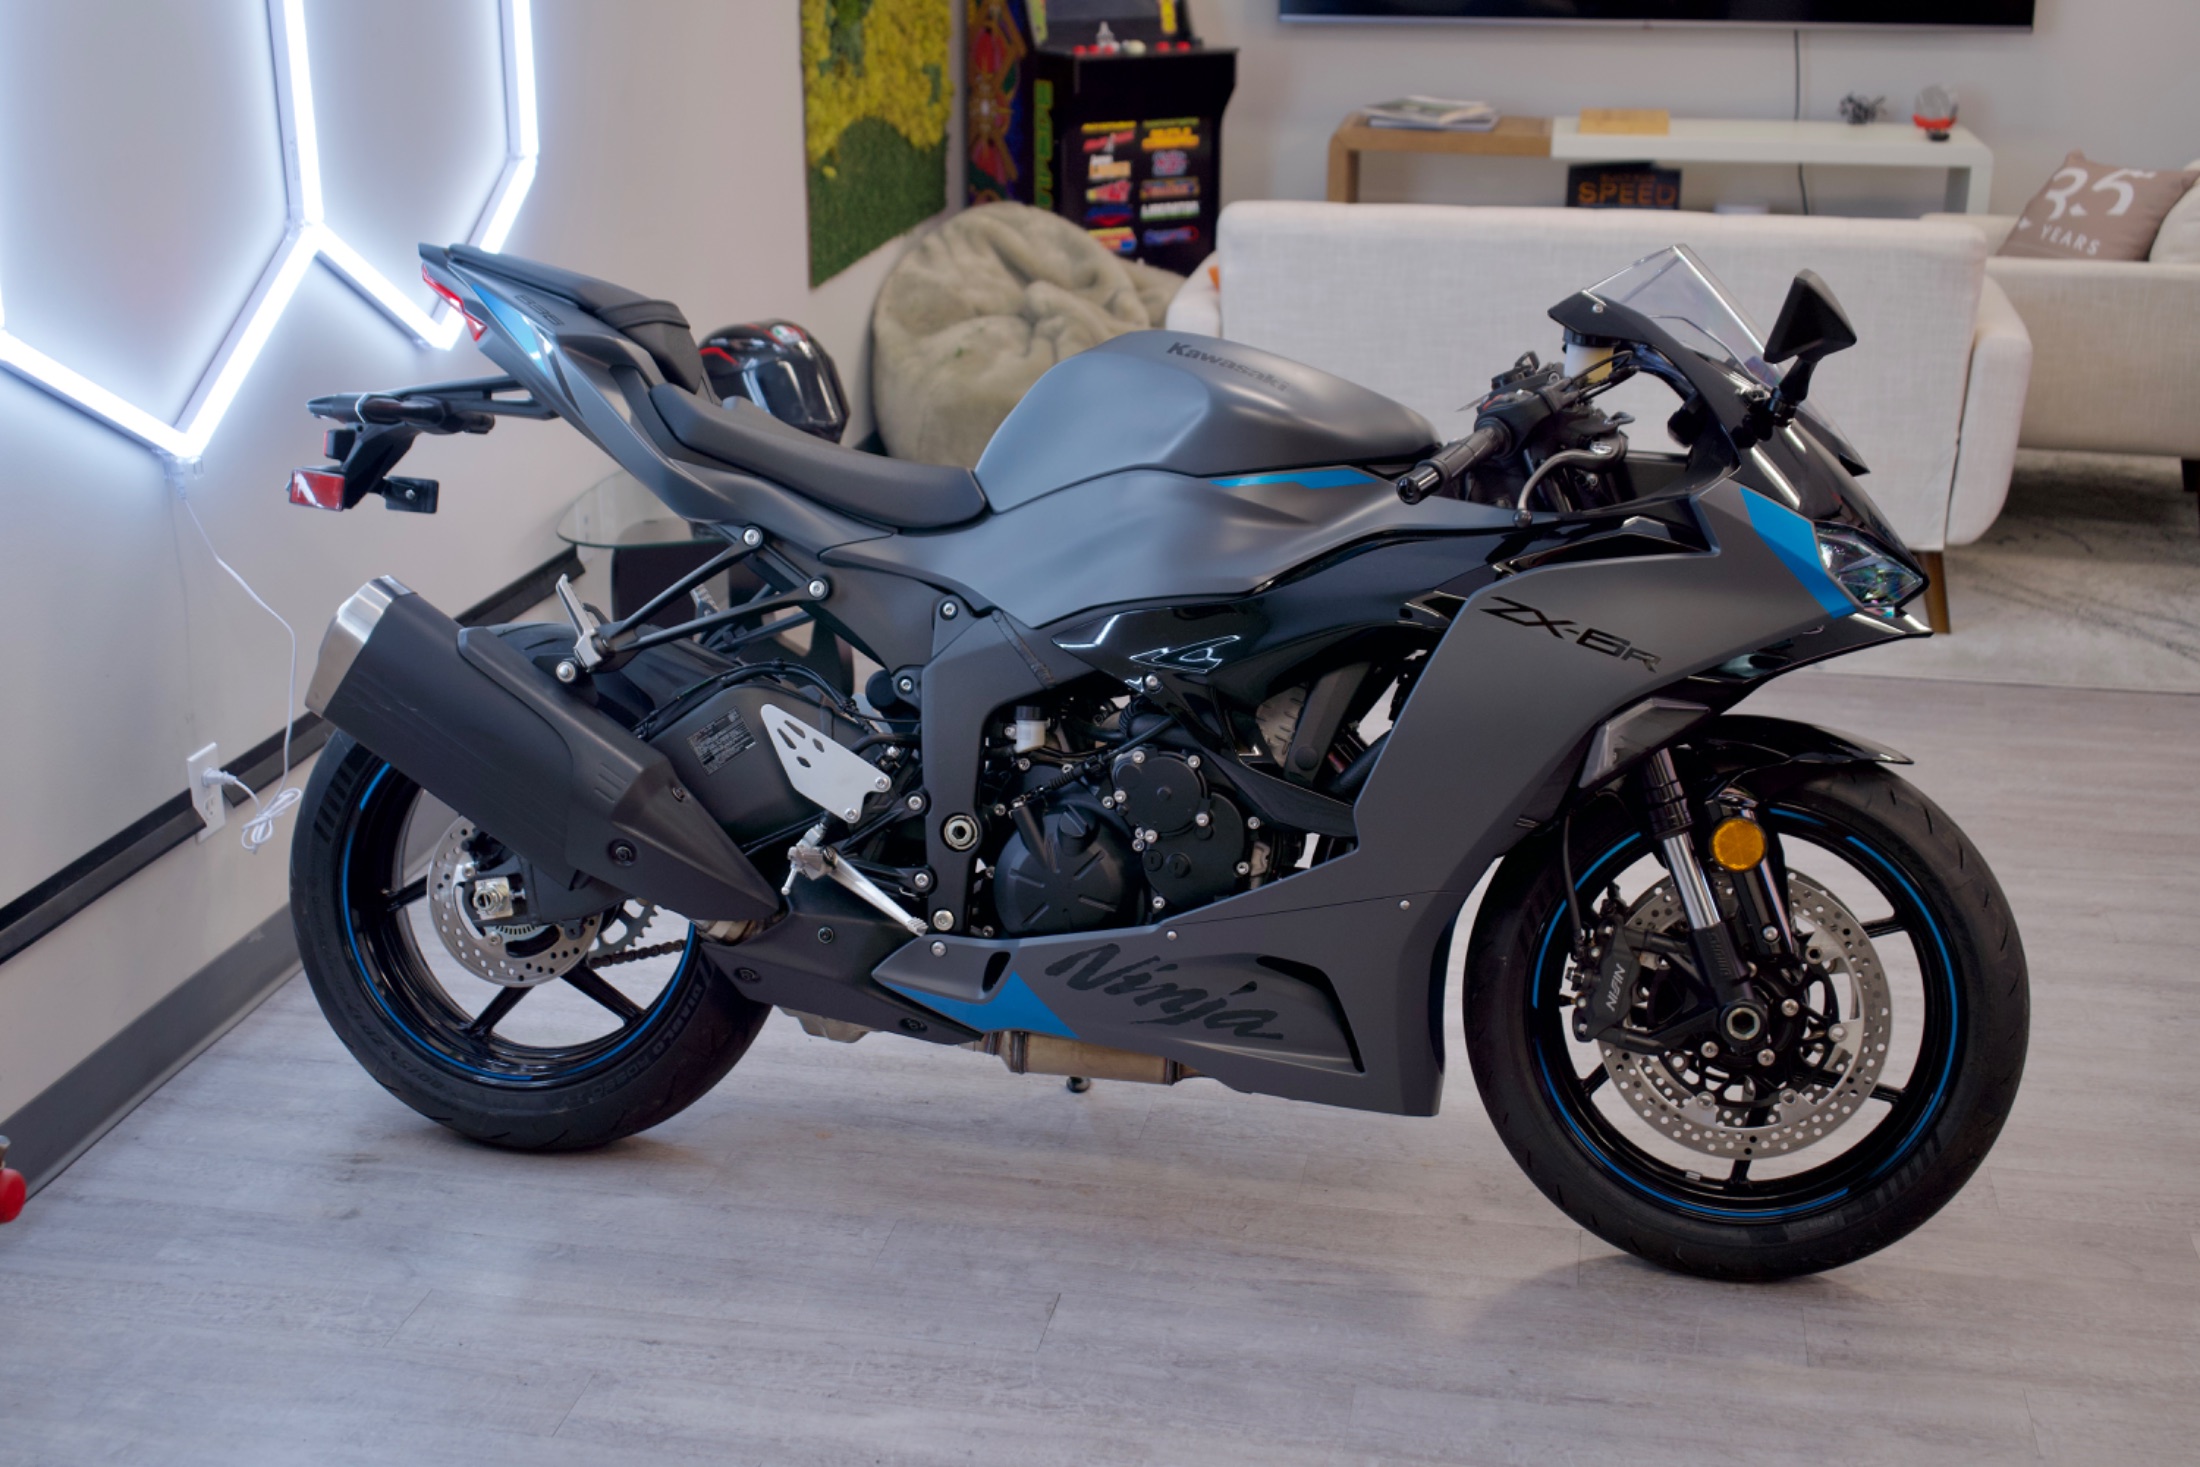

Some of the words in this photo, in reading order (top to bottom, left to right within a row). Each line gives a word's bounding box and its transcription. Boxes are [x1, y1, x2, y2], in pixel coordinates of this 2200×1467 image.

[1578, 181, 1679, 206] SPEED
[2041, 224, 2100, 256] YEARS
[1166, 341, 1290, 392] Kawasaki
[1479, 596, 1661, 674] ZX-6R
[1045, 942, 1284, 1040] Ninja
